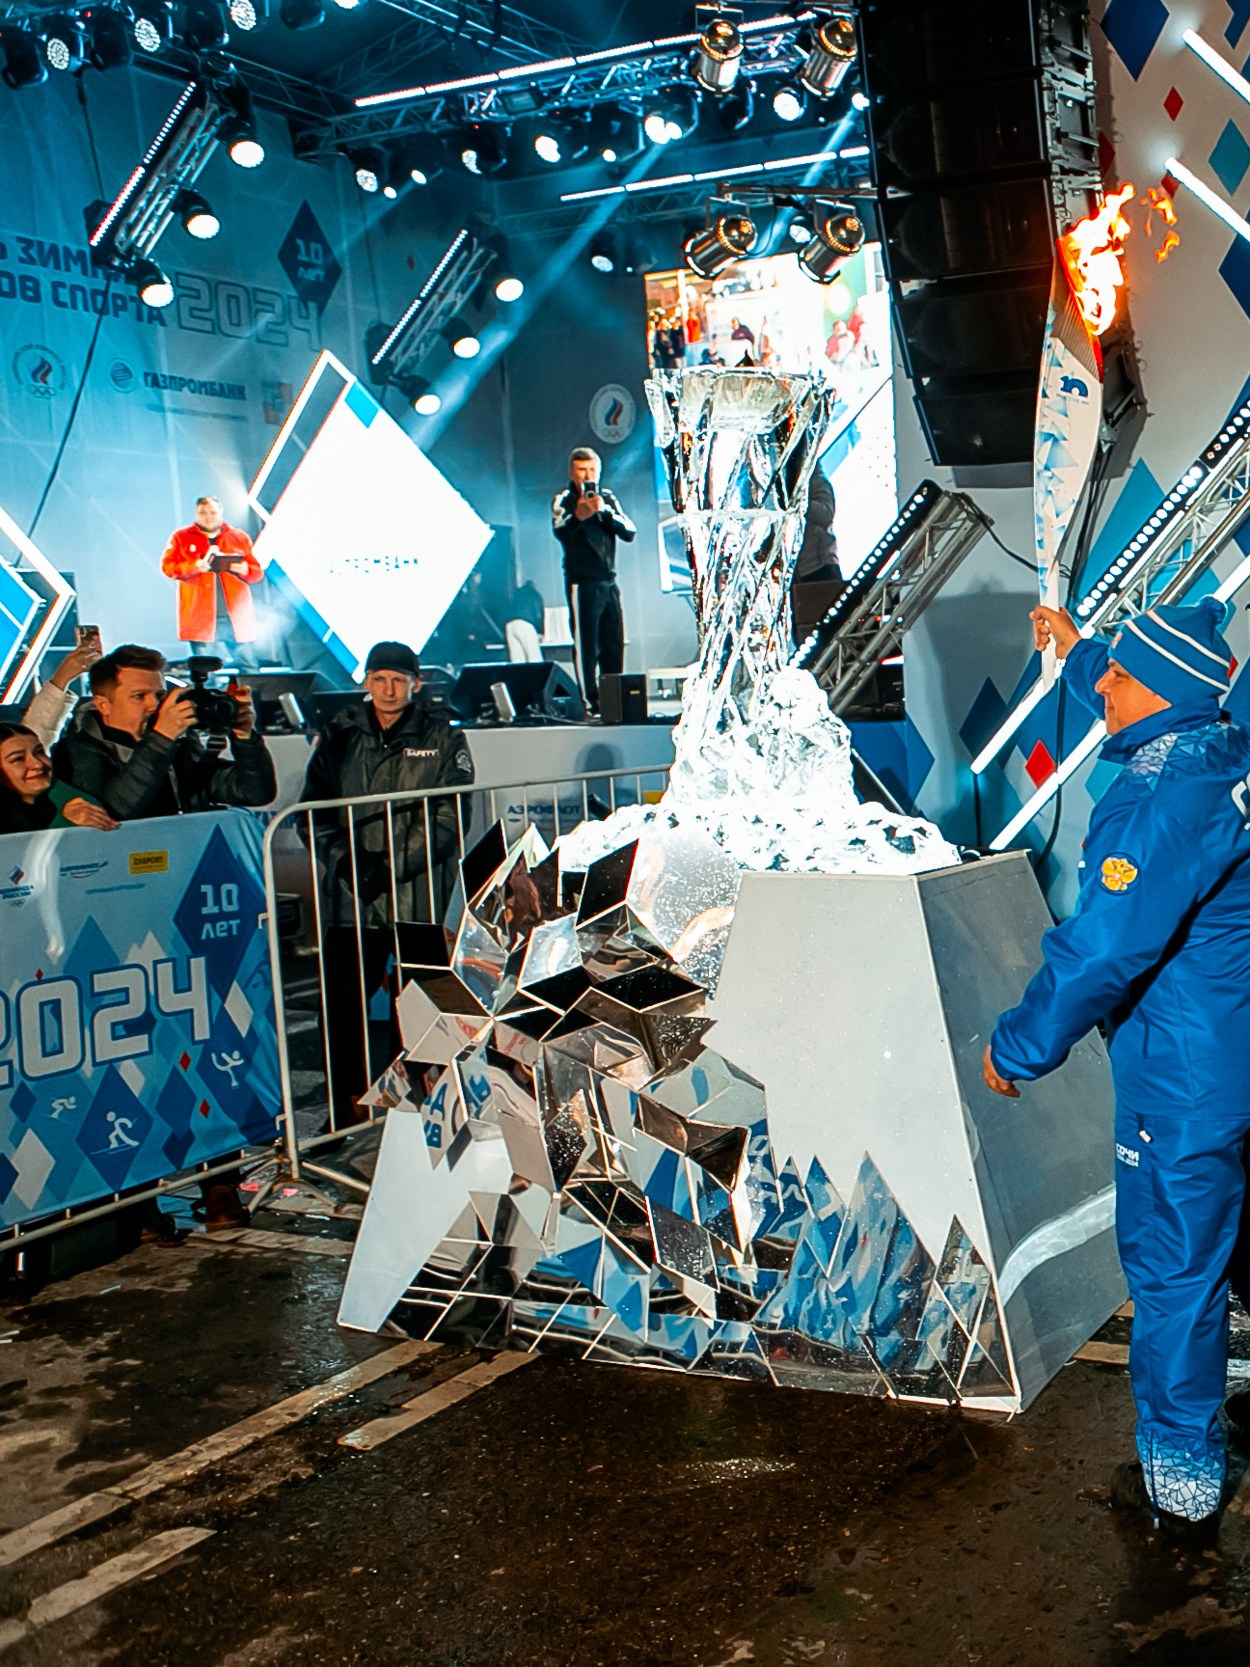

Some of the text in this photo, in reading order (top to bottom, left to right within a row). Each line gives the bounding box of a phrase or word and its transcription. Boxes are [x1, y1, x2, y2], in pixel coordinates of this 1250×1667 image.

[175, 272, 322, 352] 2024
[144, 372, 247, 401] ГАЗПРОМБАНК
[201, 883, 239, 914] 10
[0, 956, 211, 1088] 024
